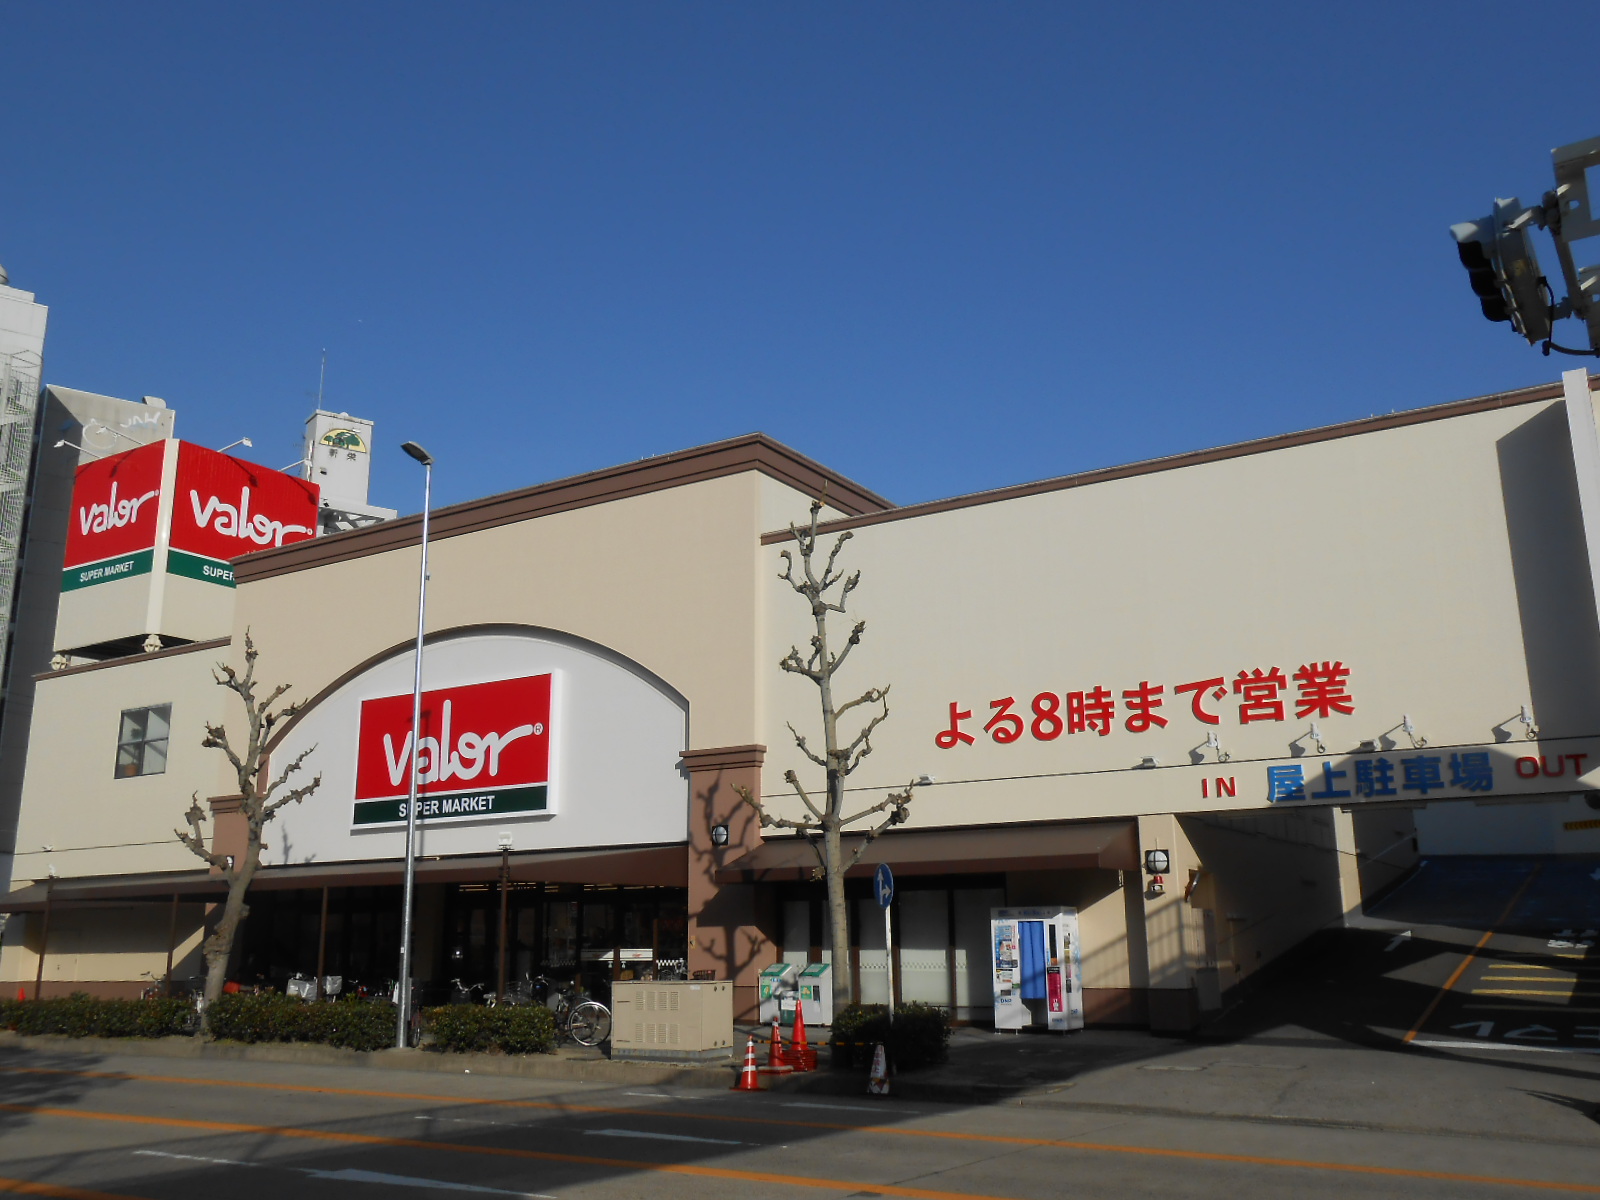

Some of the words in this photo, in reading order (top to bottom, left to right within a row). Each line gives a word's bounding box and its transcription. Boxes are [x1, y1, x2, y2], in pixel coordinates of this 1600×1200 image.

[79, 567, 104, 582] SUPER
[104, 560, 134, 578] MARKET
[934, 661, 1355, 748] よる8時まで営業
[1266, 752, 1494, 803] 屋上駐車場
[1516, 754, 1588, 778] OUT
[1202, 776, 1237, 799] IN
[399, 801, 439, 817] SPER
[442, 795, 495, 813] MARKET
